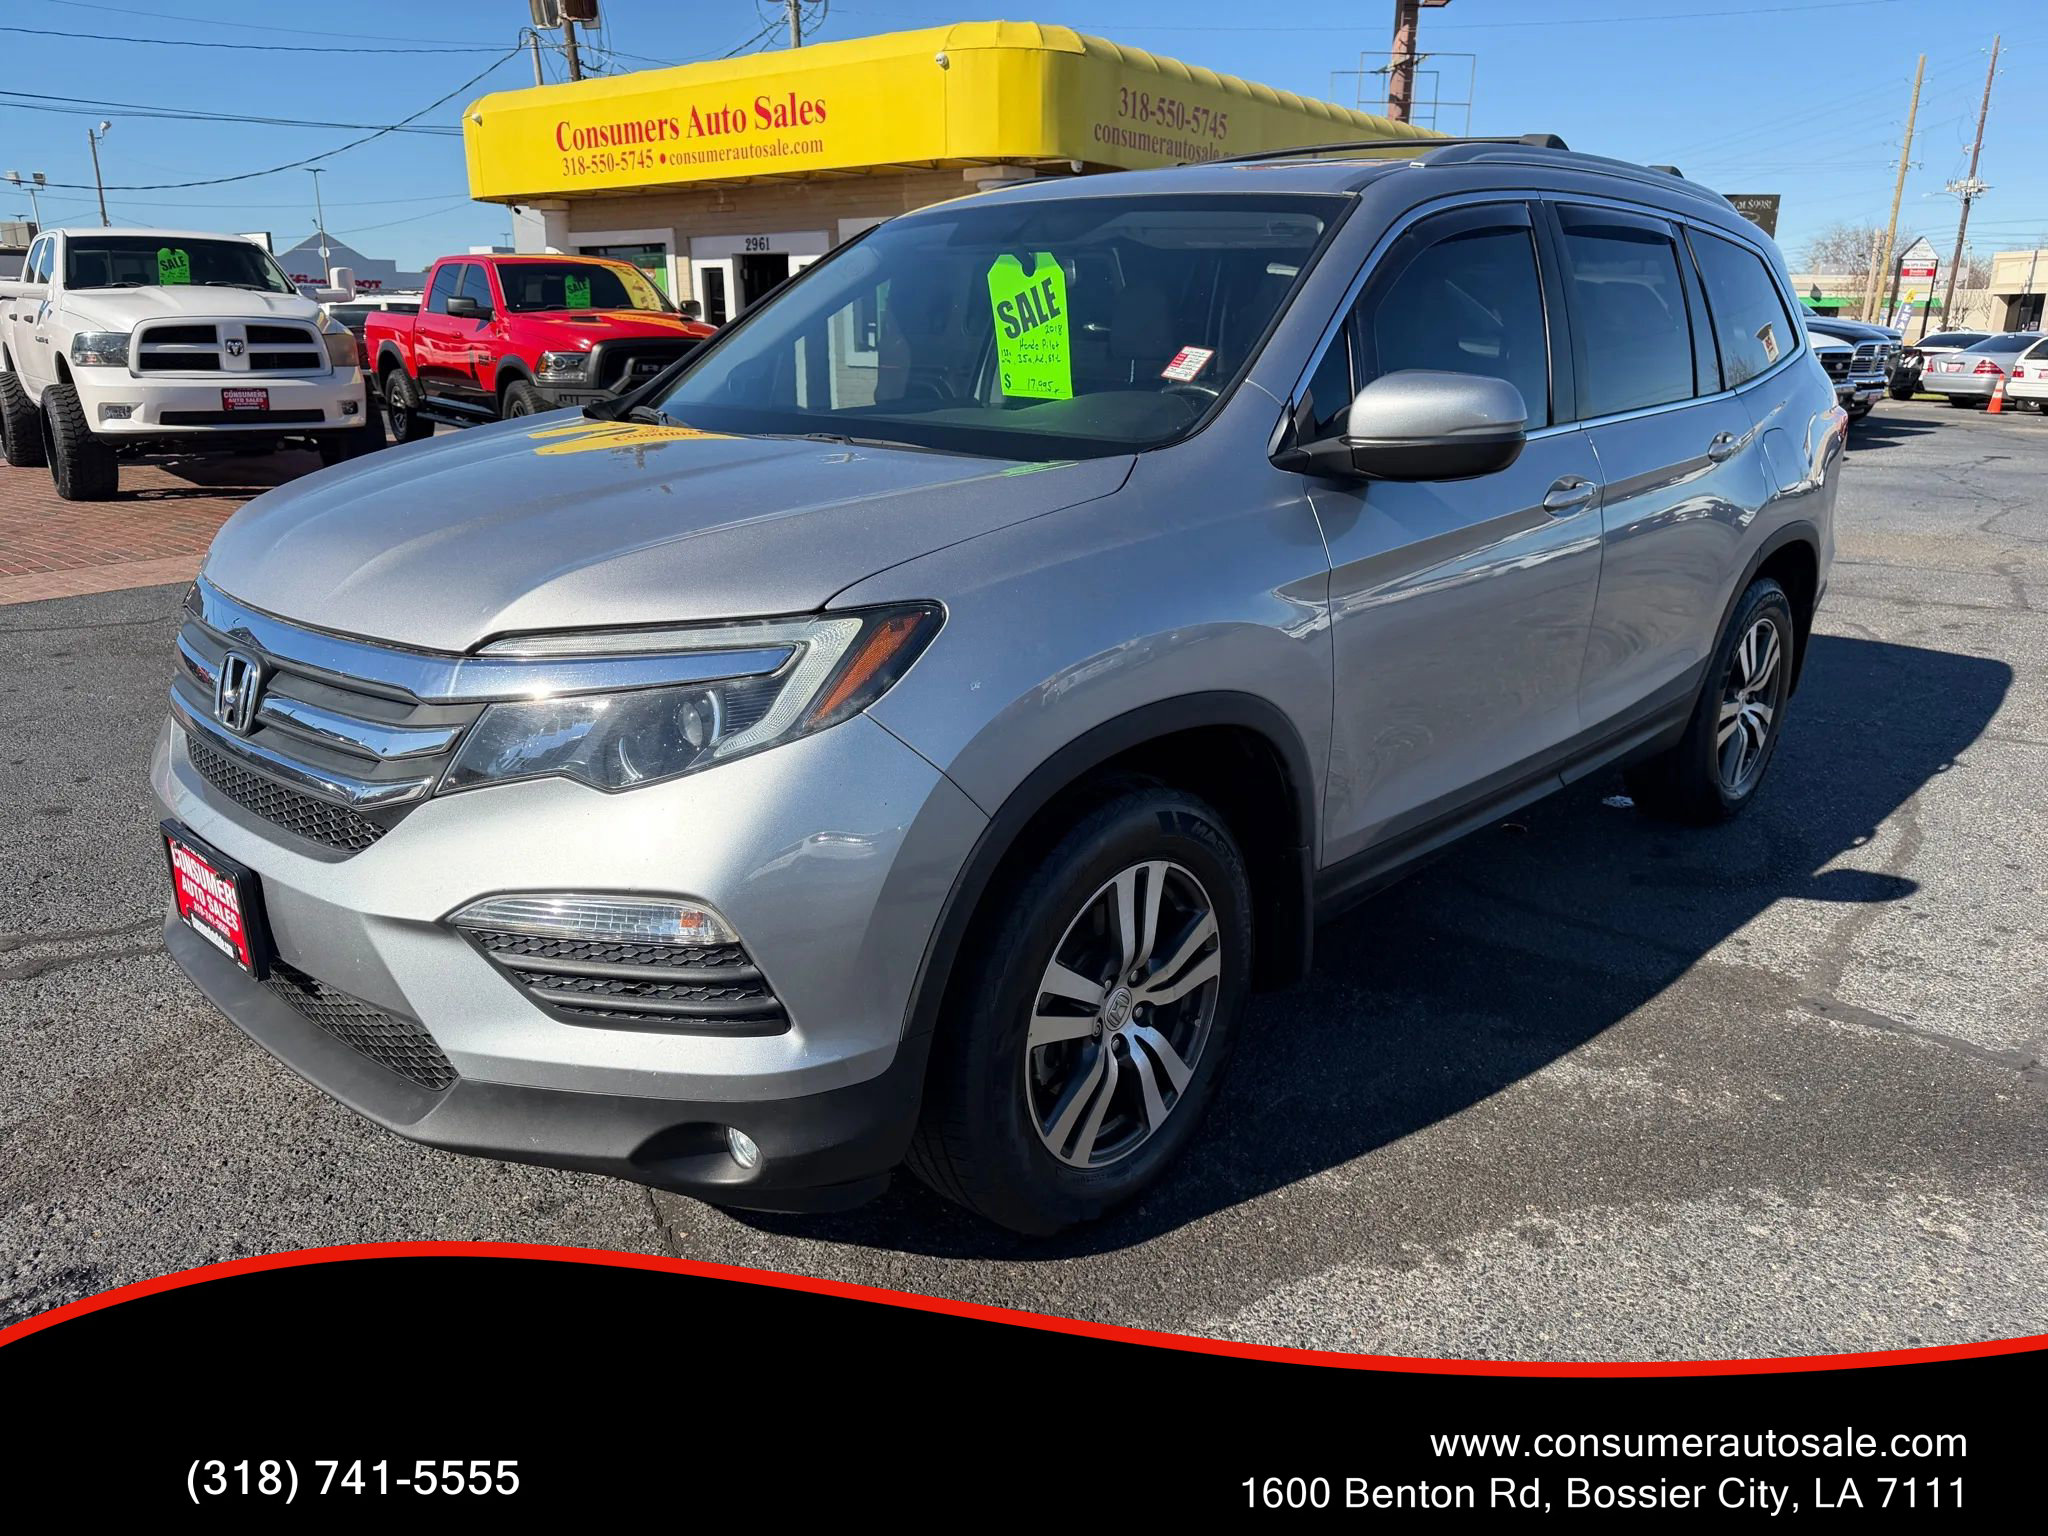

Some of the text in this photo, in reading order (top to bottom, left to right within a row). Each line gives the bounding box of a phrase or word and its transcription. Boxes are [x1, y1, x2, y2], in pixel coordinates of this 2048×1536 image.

[556, 92, 827, 152] Consumers Auto Sales
[1118, 87, 1227, 140] 318-550-5745
[562, 138, 823, 177] 318-550-5745 consumerautosale.com
[1094, 122, 1237, 163] consumerautosale
[160, 255, 187, 271] SALE
[745, 236, 770, 251] 2961
[566, 280, 588, 294] SALE
[996, 277, 1061, 339] SALE
[1004, 373, 1012, 390] $
[181, 874, 239, 931] AUTO SALES
